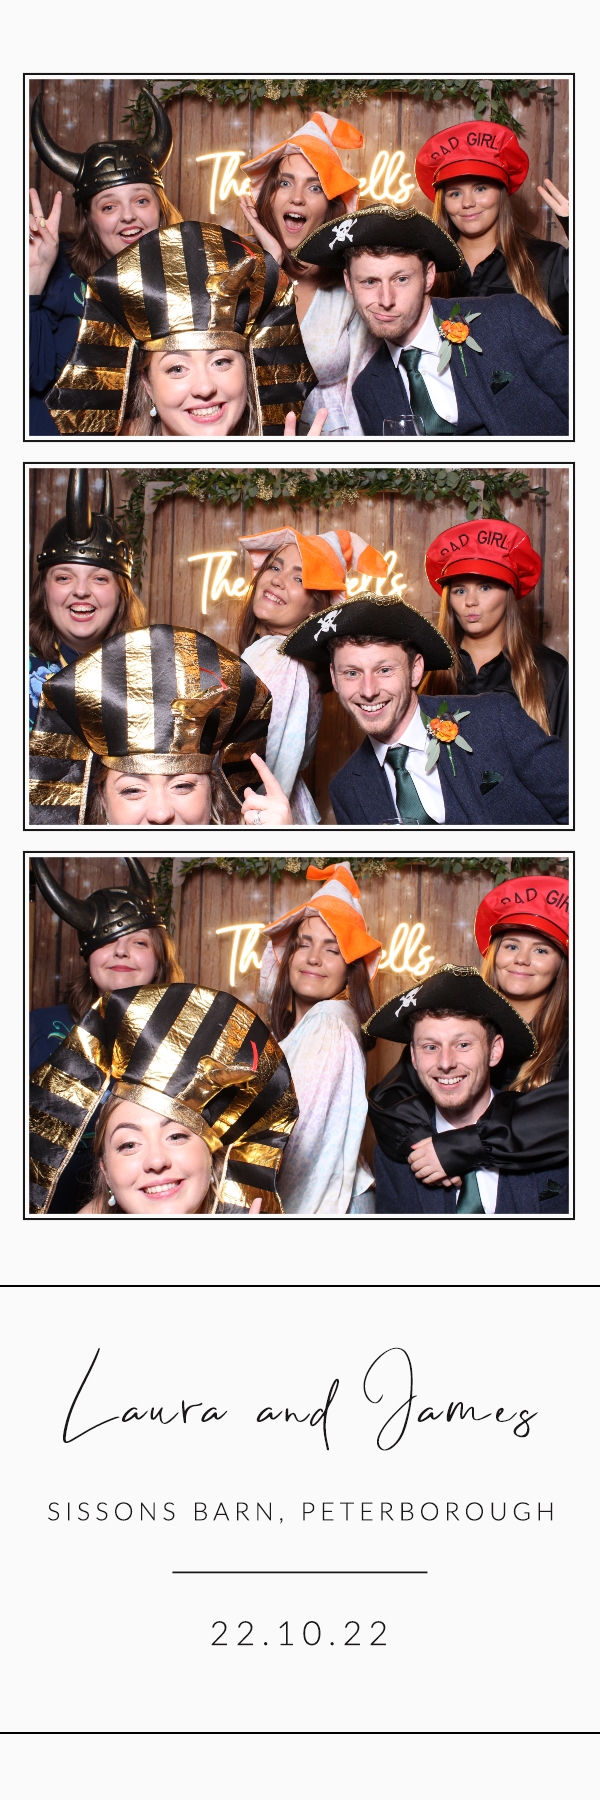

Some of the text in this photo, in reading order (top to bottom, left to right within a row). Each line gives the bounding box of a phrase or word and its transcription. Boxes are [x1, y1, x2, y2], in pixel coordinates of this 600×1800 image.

[466, 132, 499, 150] GIRL
[477, 530, 508, 550] GIRL
[188, 551, 252, 614] The
